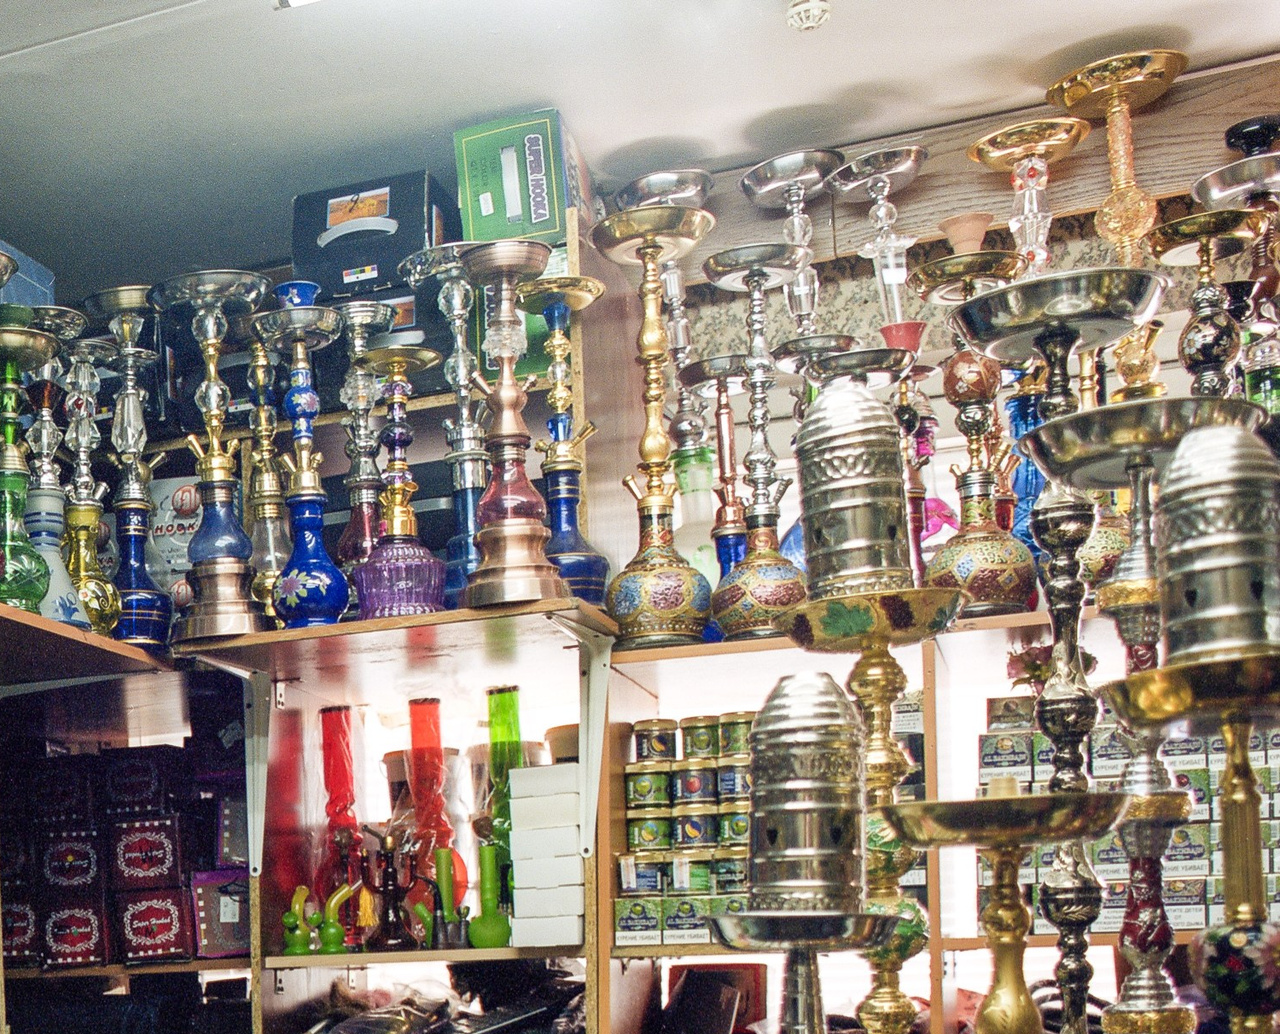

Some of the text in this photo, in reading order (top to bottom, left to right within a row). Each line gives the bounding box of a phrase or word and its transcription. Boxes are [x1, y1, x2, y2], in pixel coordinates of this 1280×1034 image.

[525, 134, 550, 223] SUPER HOOKA
[154, 522, 198, 537] HOOK
[132, 916, 171, 929] Super Hookah
